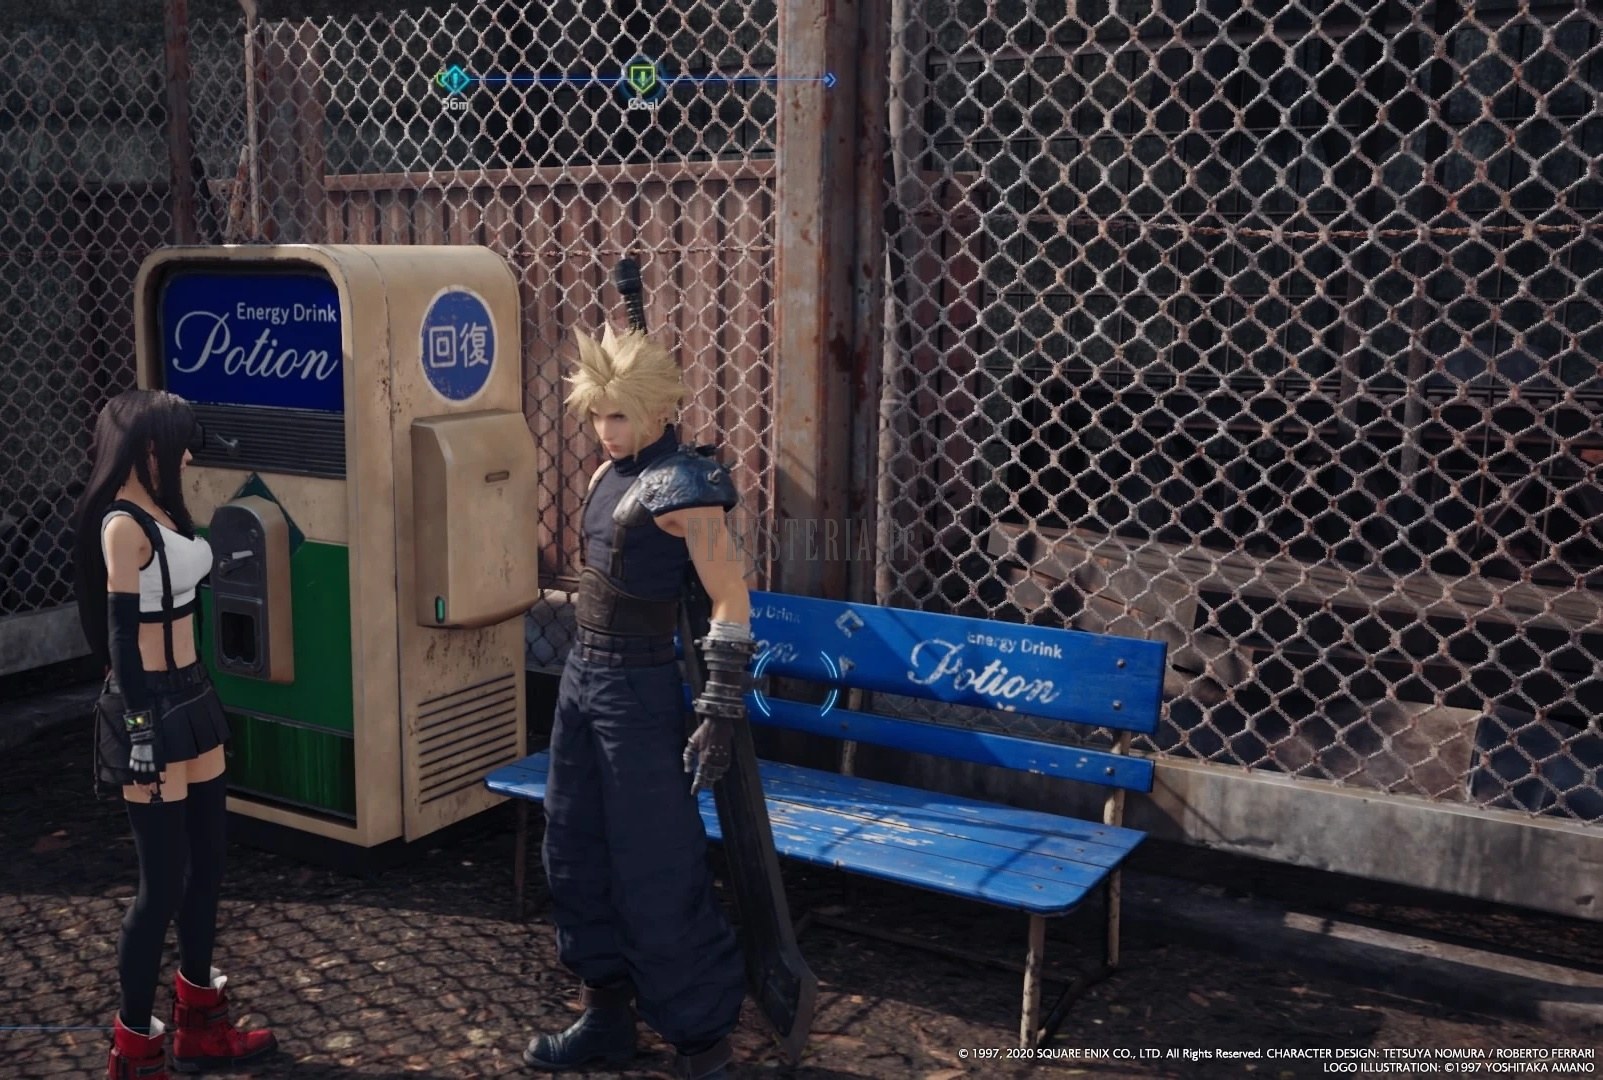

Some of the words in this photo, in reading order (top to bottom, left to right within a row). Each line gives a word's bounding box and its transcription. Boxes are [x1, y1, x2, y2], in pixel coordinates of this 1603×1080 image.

[236, 302, 290, 325] Energy
[293, 303, 338, 323] Drink
[172, 310, 339, 381] Potion
[429, 321, 490, 369] 回復
[967, 631, 1018, 654] Energy
[1020, 638, 1063, 660] Drink
[906, 637, 1062, 705] Potion
